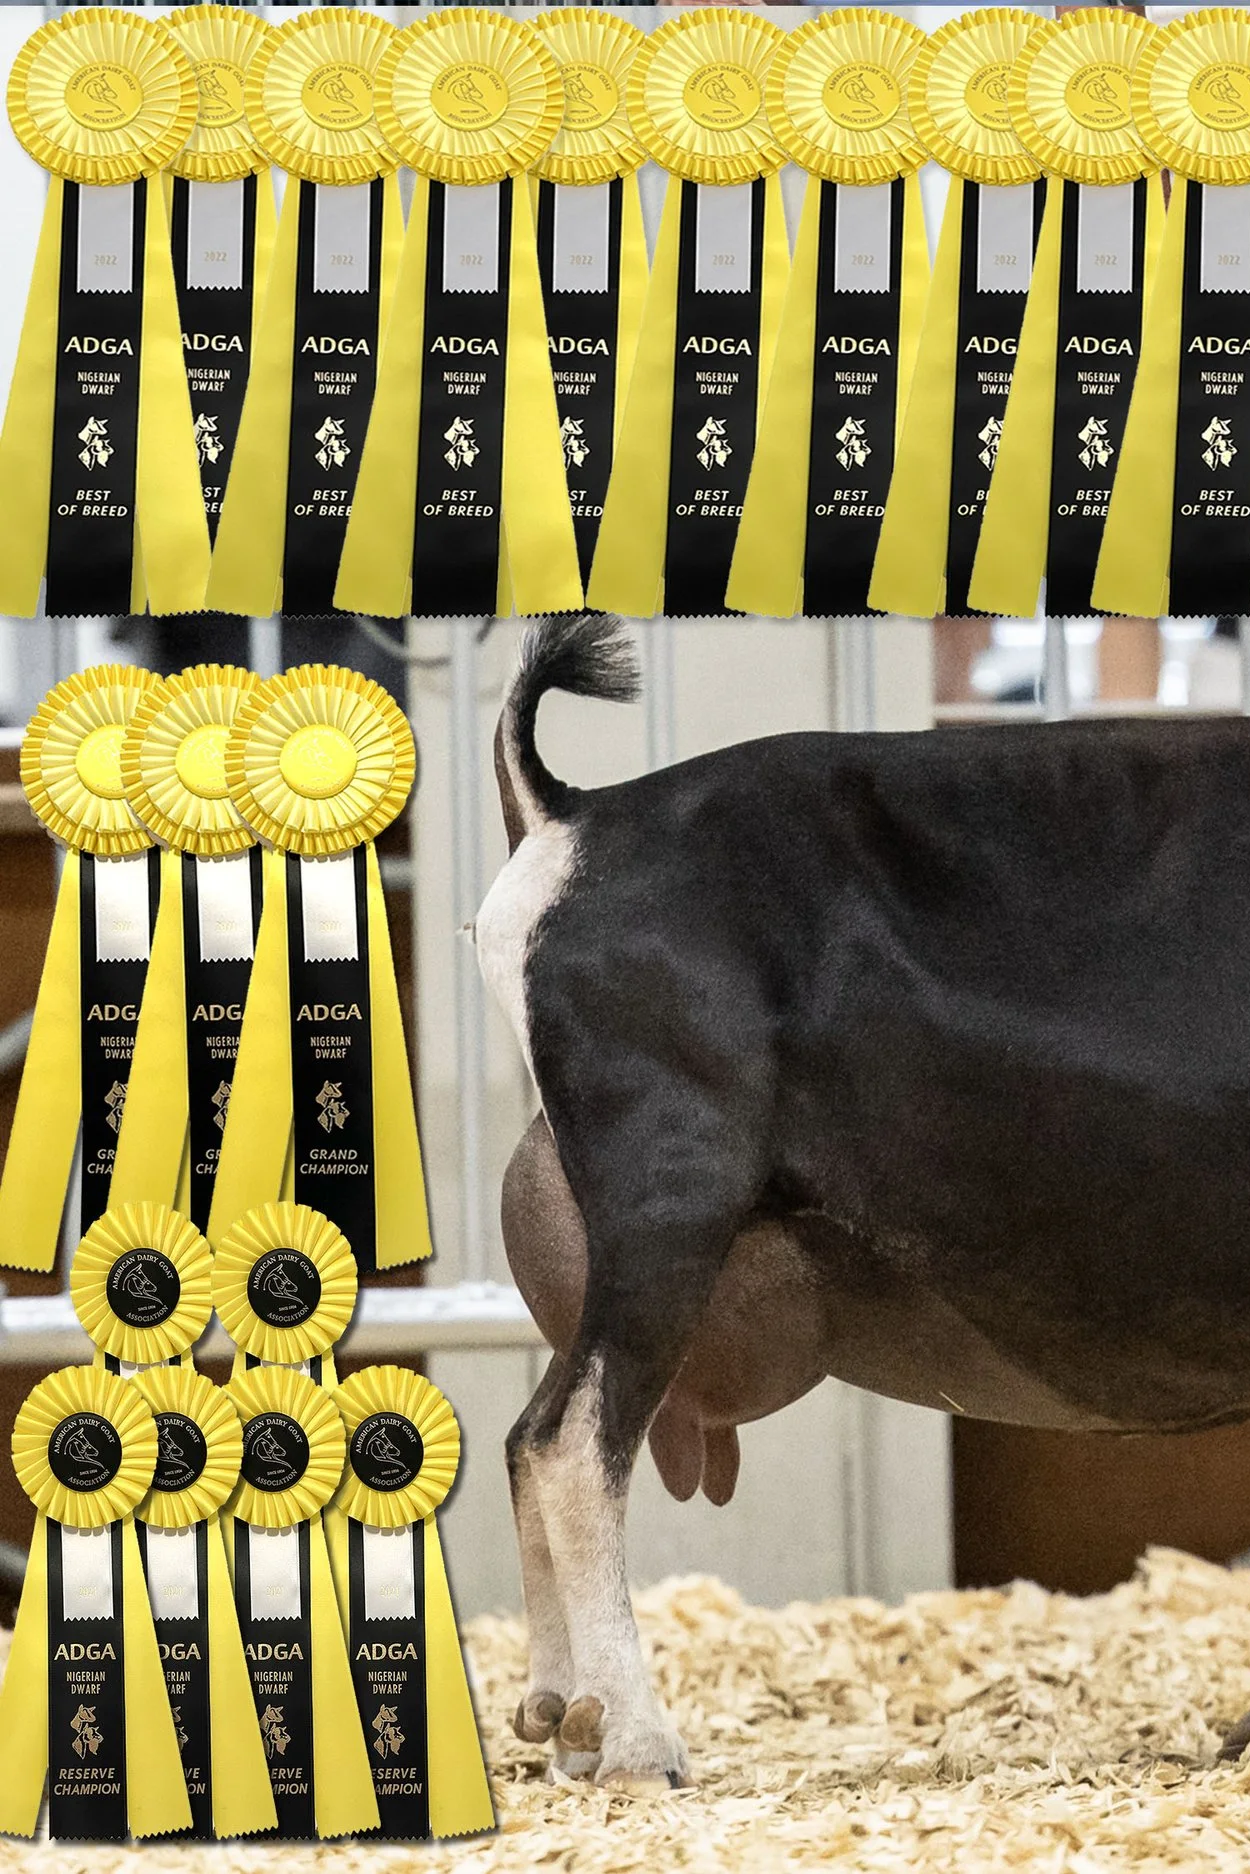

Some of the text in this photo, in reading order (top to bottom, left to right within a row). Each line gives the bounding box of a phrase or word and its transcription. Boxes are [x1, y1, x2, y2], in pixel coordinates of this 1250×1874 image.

[94, 254, 118, 266] 2022
[204, 251, 228, 263] 2022
[331, 254, 355, 266] 2022
[460, 254, 484, 266] 2022
[570, 254, 594, 266] 2022
[712, 254, 736, 266] 2022
[851, 254, 875, 266] 2022
[994, 254, 1018, 266] 2022
[1094, 254, 1118, 266] 2022
[1217, 254, 1241, 266] 2022
[64, 336, 134, 356] ADGA
[301, 336, 371, 356] ADGA
[430, 336, 500, 356] ADGA
[682, 336, 752, 356] ADGA
[821, 336, 891, 356] ADGA
[964, 336, 1017, 355] ADG
[1064, 336, 1134, 356] ADGA
[77, 371, 121, 383] NIGERIAN
[187, 368, 231, 380] NIGERIAN
[314, 371, 358, 383] NIGERIAN
[443, 371, 487, 383] NIGERIAN
[553, 371, 597, 383] NIGERIAN
[695, 371, 739, 383] NIGERIAN
[834, 371, 878, 383] NIGERIAN
[977, 371, 1013, 383] NIGERIA
[1077, 371, 1121, 383] NIGERIAN
[1200, 371, 1244, 383] NIGERIAN
[81, 384, 115, 396] DWARF
[191, 381, 225, 393] DWARF
[318, 384, 352, 396] DWARF
[447, 384, 481, 396] DWARF
[557, 384, 591, 396] DWARF
[699, 384, 733, 396] DWARF
[838, 384, 872, 396] DWARF
[981, 384, 1010, 396] DWAR
[1081, 384, 1115, 396] DWARF
[1204, 384, 1238, 396] DWARF
[76, 489, 111, 501] BEST
[313, 489, 348, 501] BEST
[442, 489, 477, 501] BEST
[568, 490, 588, 501] ST
[694, 489, 729, 501] BEST
[833, 489, 868, 501] BEST
[1076, 489, 1111, 501] BEST
[1199, 489, 1234, 501] BEST
[57, 504, 128, 517] OF BREED
[294, 504, 353, 517] OF BREE
[423, 504, 494, 517] OF BREED
[570, 505, 604, 517] REED
[675, 504, 744, 517] OF BREED
[814, 504, 885, 517] OF BREED
[957, 504, 978, 516] OF
[1057, 504, 1109, 517] OF BRE
[1180, 504, 1250, 517] OF BREED
[87, 1003, 141, 1022] ADG
[192, 1003, 244, 1022] ADG
[297, 1003, 363, 1021] ADGA
[100, 1036, 136, 1048] NIGERIA
[206, 1036, 240, 1048] NIGERIA
[310, 1036, 352, 1048] NIGERIAN
[211, 1048, 238, 1060] DWAR
[315, 1048, 347, 1060] DWARF
[309, 1148, 358, 1160] GRAND
[300, 1163, 369, 1175] CHAMPION
[112, 1254, 174, 1290] AMERICAN DAIRY GOAT
[253, 1254, 315, 1290] AMERICAN DAIRY GOAT
[125, 1304, 169, 1323] ASSOCIATION
[266, 1304, 310, 1323] ASSOCIATION
[54, 1418, 116, 1454] AMERICAN DAIRY GOAT
[163, 1418, 186, 1427] DAIRY
[185, 1424, 201, 1444] GOAT
[265, 1418, 288, 1427] DAIRY
[287, 1424, 303, 1444] GOAT
[356, 1418, 418, 1454] AMERICAN DAIRY GOAT
[67, 1468, 111, 1487] ASSOCIATION
[254, 1468, 298, 1487] ASSOCIATION
[369, 1468, 413, 1487] ASSOCIATION
[54, 1643, 117, 1661] ADGA
[158, 1643, 202, 1661] DGA
[356, 1643, 418, 1661] ADGA
[66, 1671, 106, 1682] NIGERIAN
[166, 1671, 191, 1682] ERIAN
[254, 1671, 293, 1682] NIGERIAN
[368, 1671, 407, 1682] NIGERIAN
[71, 1683, 101, 1694] DWARF
[168, 1683, 186, 1695] ARF
[258, 1683, 289, 1694] DWARF
[372, 1683, 403, 1694] DWARF
[59, 1767, 116, 1780] RESERVE
[54, 1783, 121, 1796] CHAMPION
